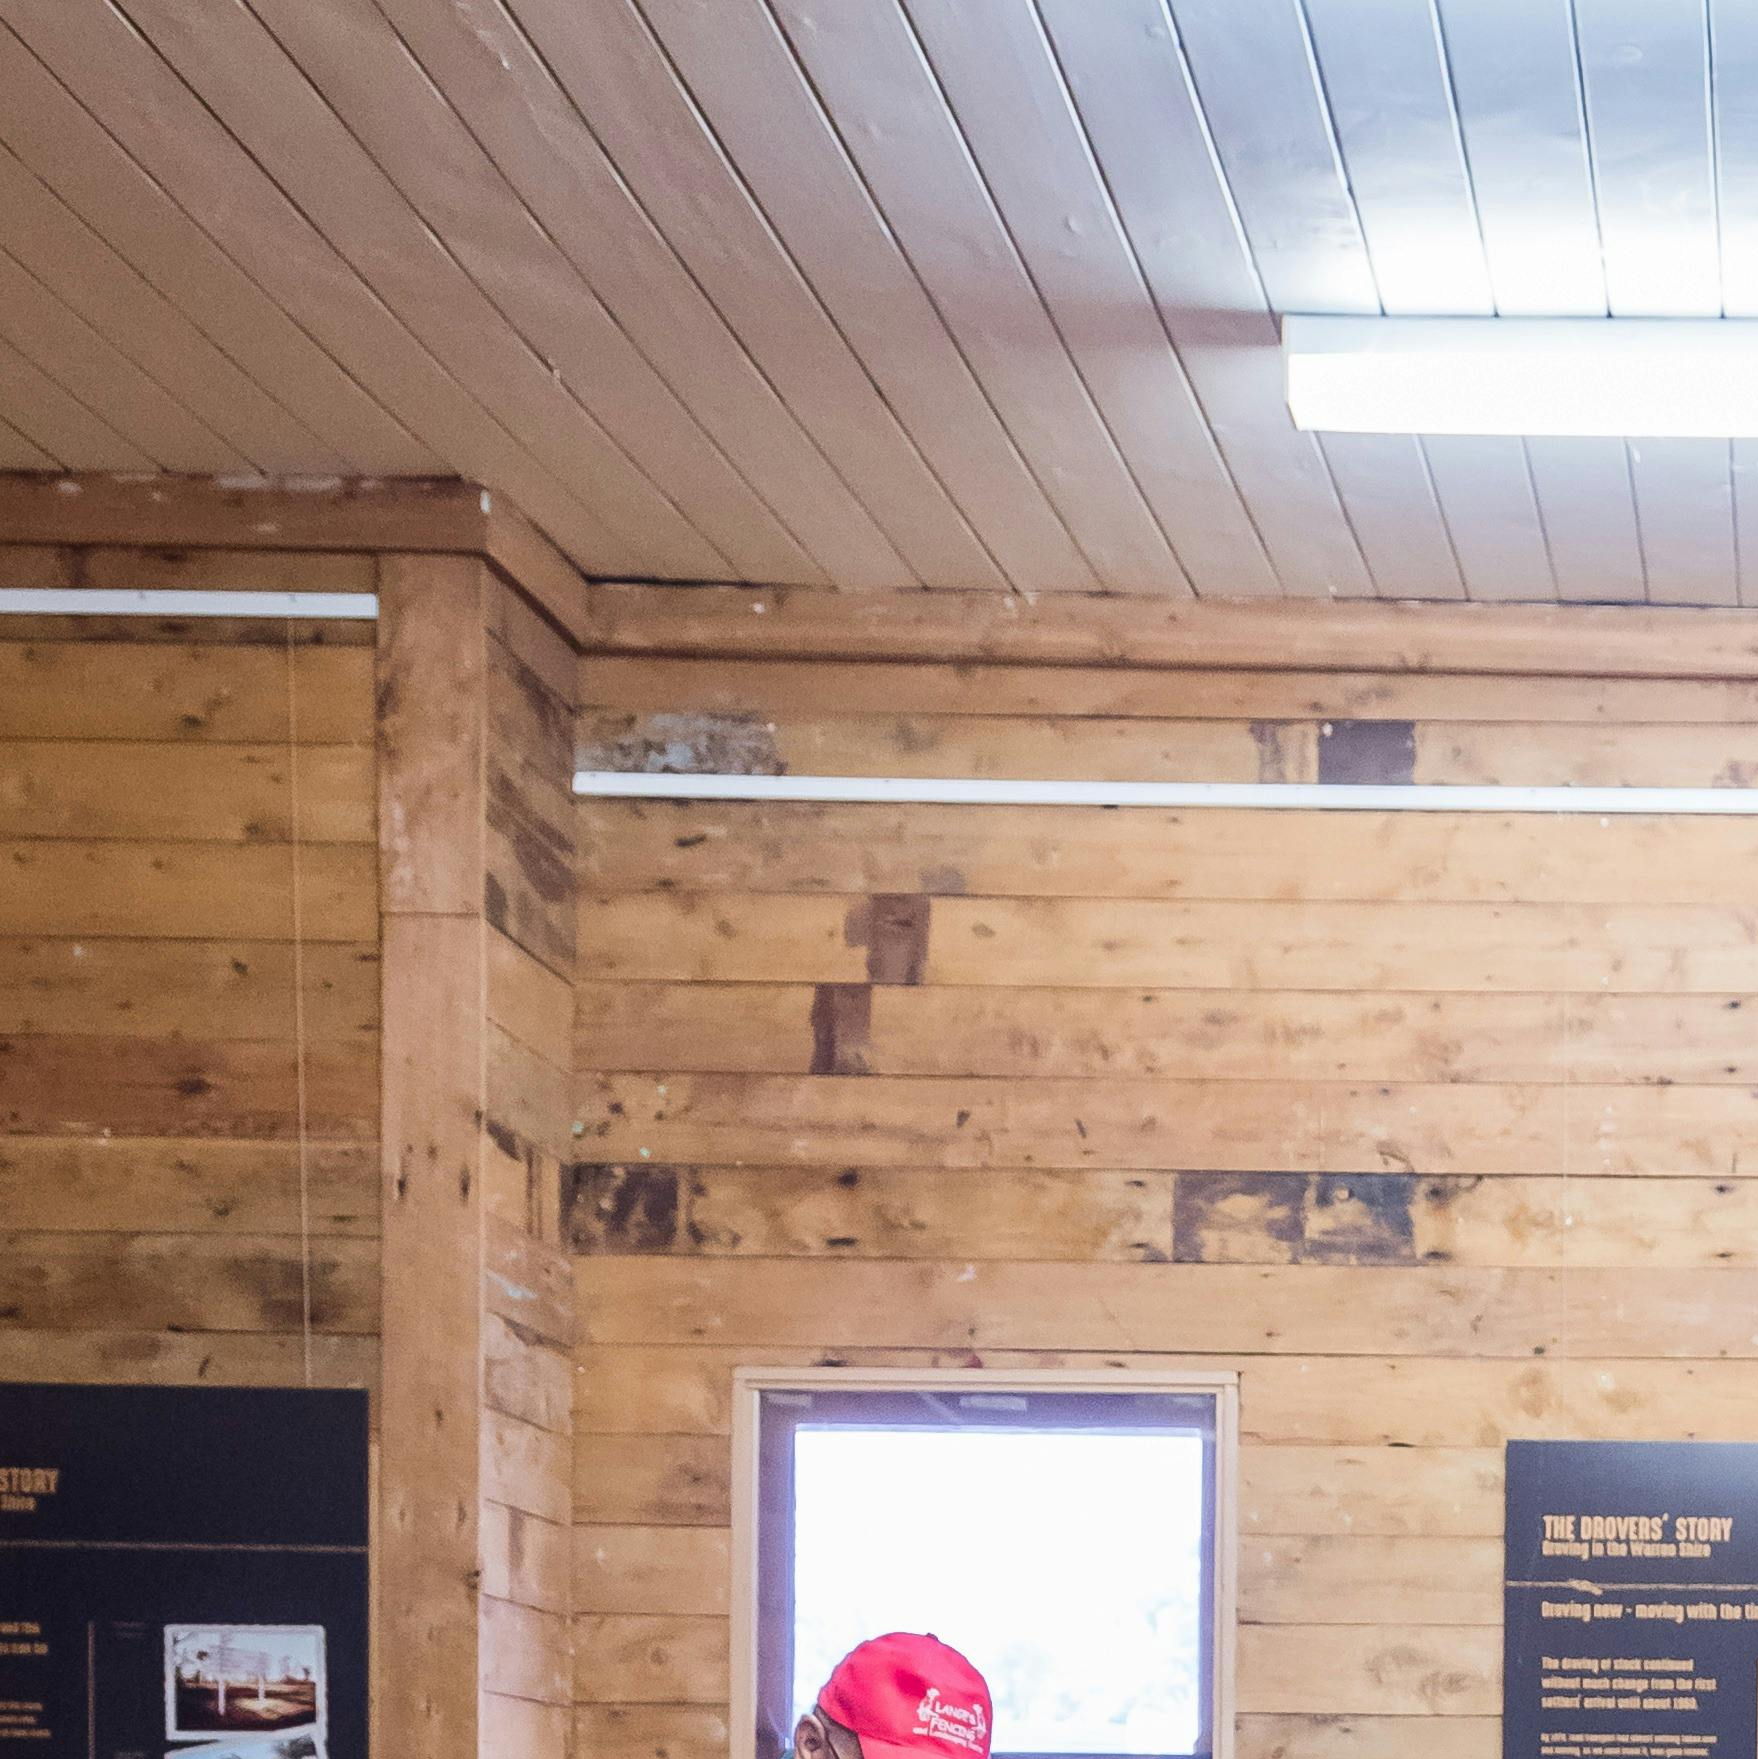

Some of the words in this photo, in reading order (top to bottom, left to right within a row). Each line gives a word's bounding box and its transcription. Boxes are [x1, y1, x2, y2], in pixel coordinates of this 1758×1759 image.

[1543, 1515, 1575, 1540] THE
[1580, 1512, 1669, 1541] DROVERS'
[1675, 1517, 1734, 1542] STORY
[1542, 1541, 1589, 1561] Droving
[1607, 1542, 1628, 1557] the
[1541, 1600, 1591, 1623] Droving
[1594, 1603, 1623, 1619] now
[1635, 1601, 1684, 1624] moving
[1686, 1602, 1717, 1620] with
[1720, 1603, 1742, 1620] the
